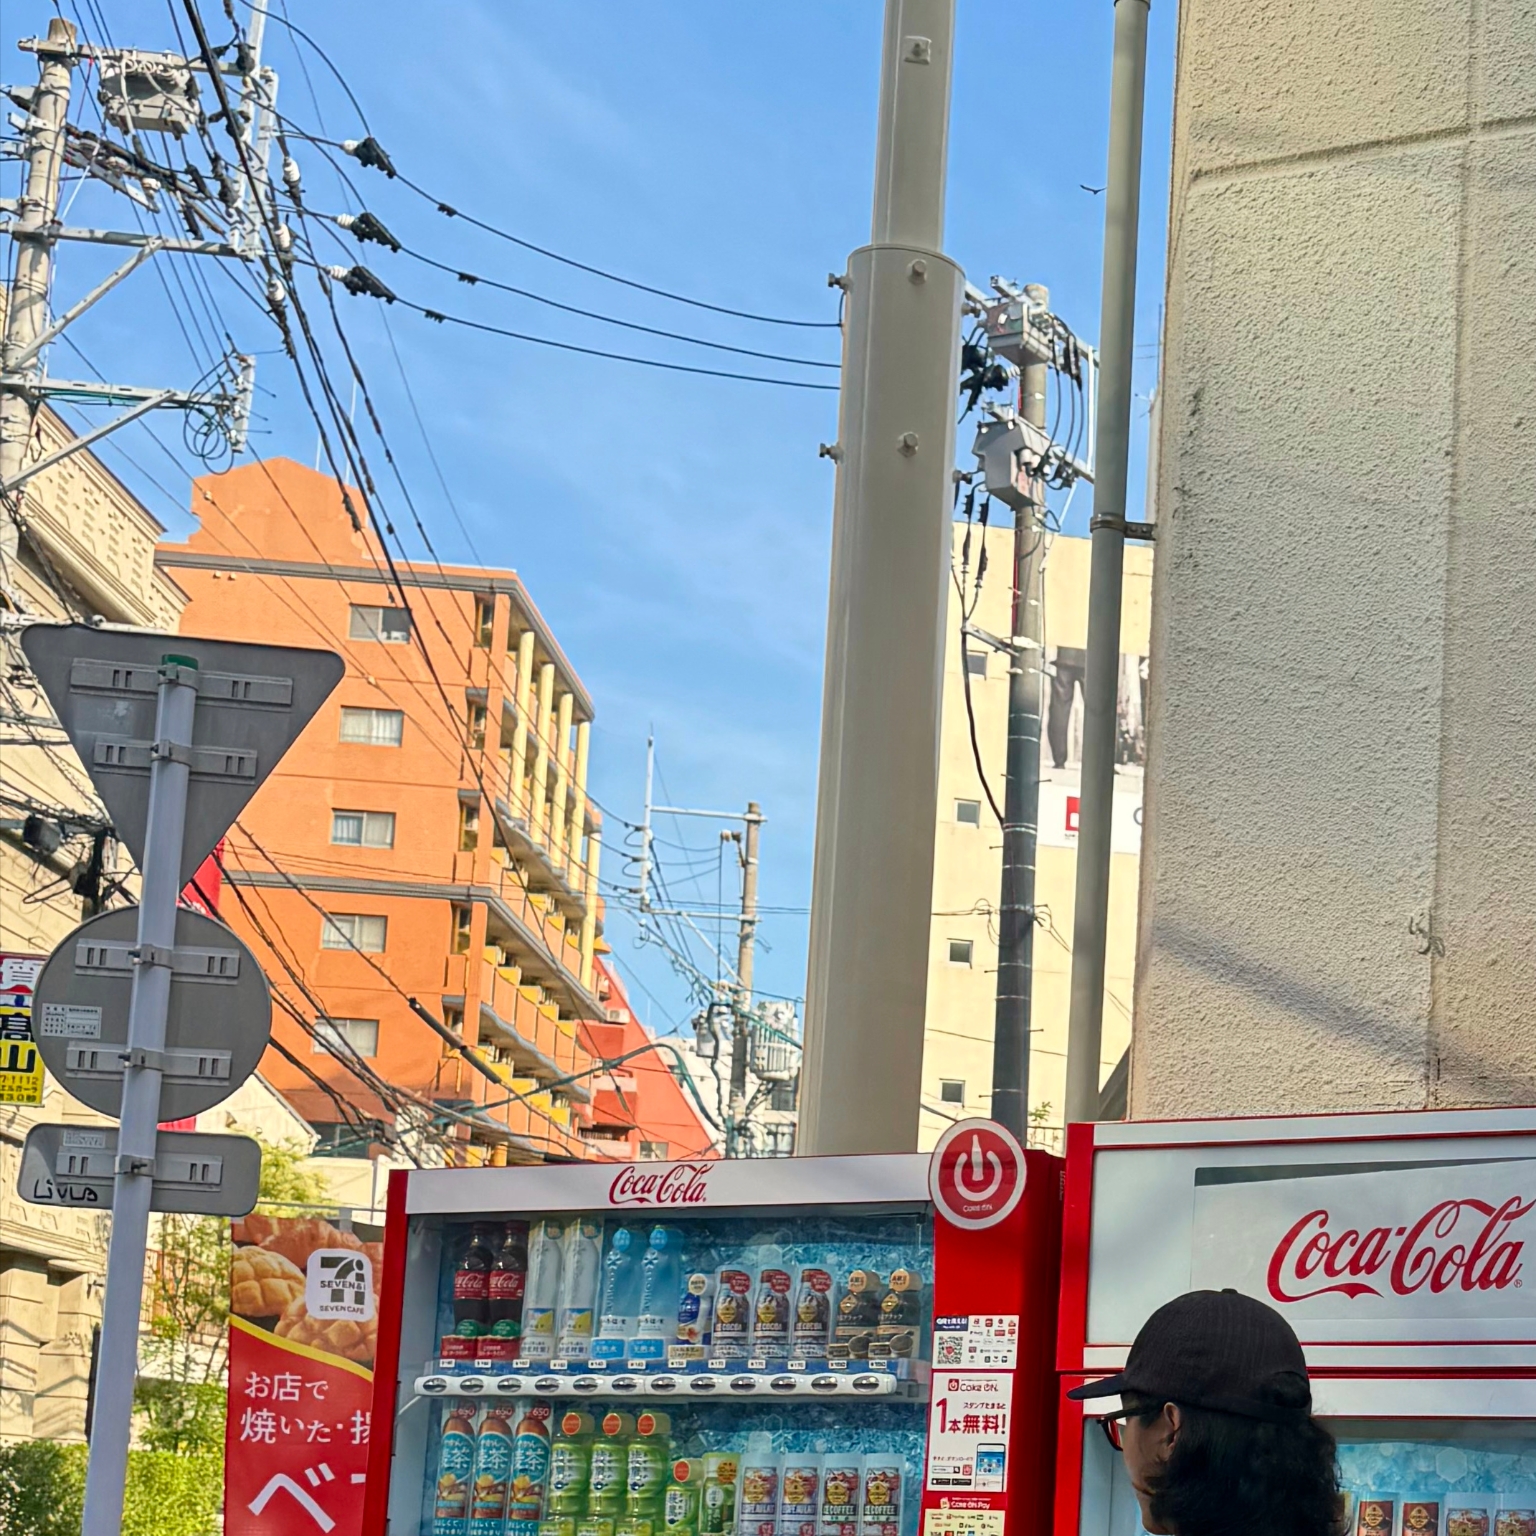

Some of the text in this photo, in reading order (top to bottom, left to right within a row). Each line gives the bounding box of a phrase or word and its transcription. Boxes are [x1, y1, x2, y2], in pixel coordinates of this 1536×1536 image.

[609, 1164, 714, 1205] Coca-Cola
[319, 1305, 345, 1313] SEVEN
[244, 1371, 329, 1401] お店で
[960, 1383, 982, 1393] Coke
[458, 1408, 475, 1416] 650
[496, 1408, 513, 1416] 650
[533, 1408, 550, 1416] 650
